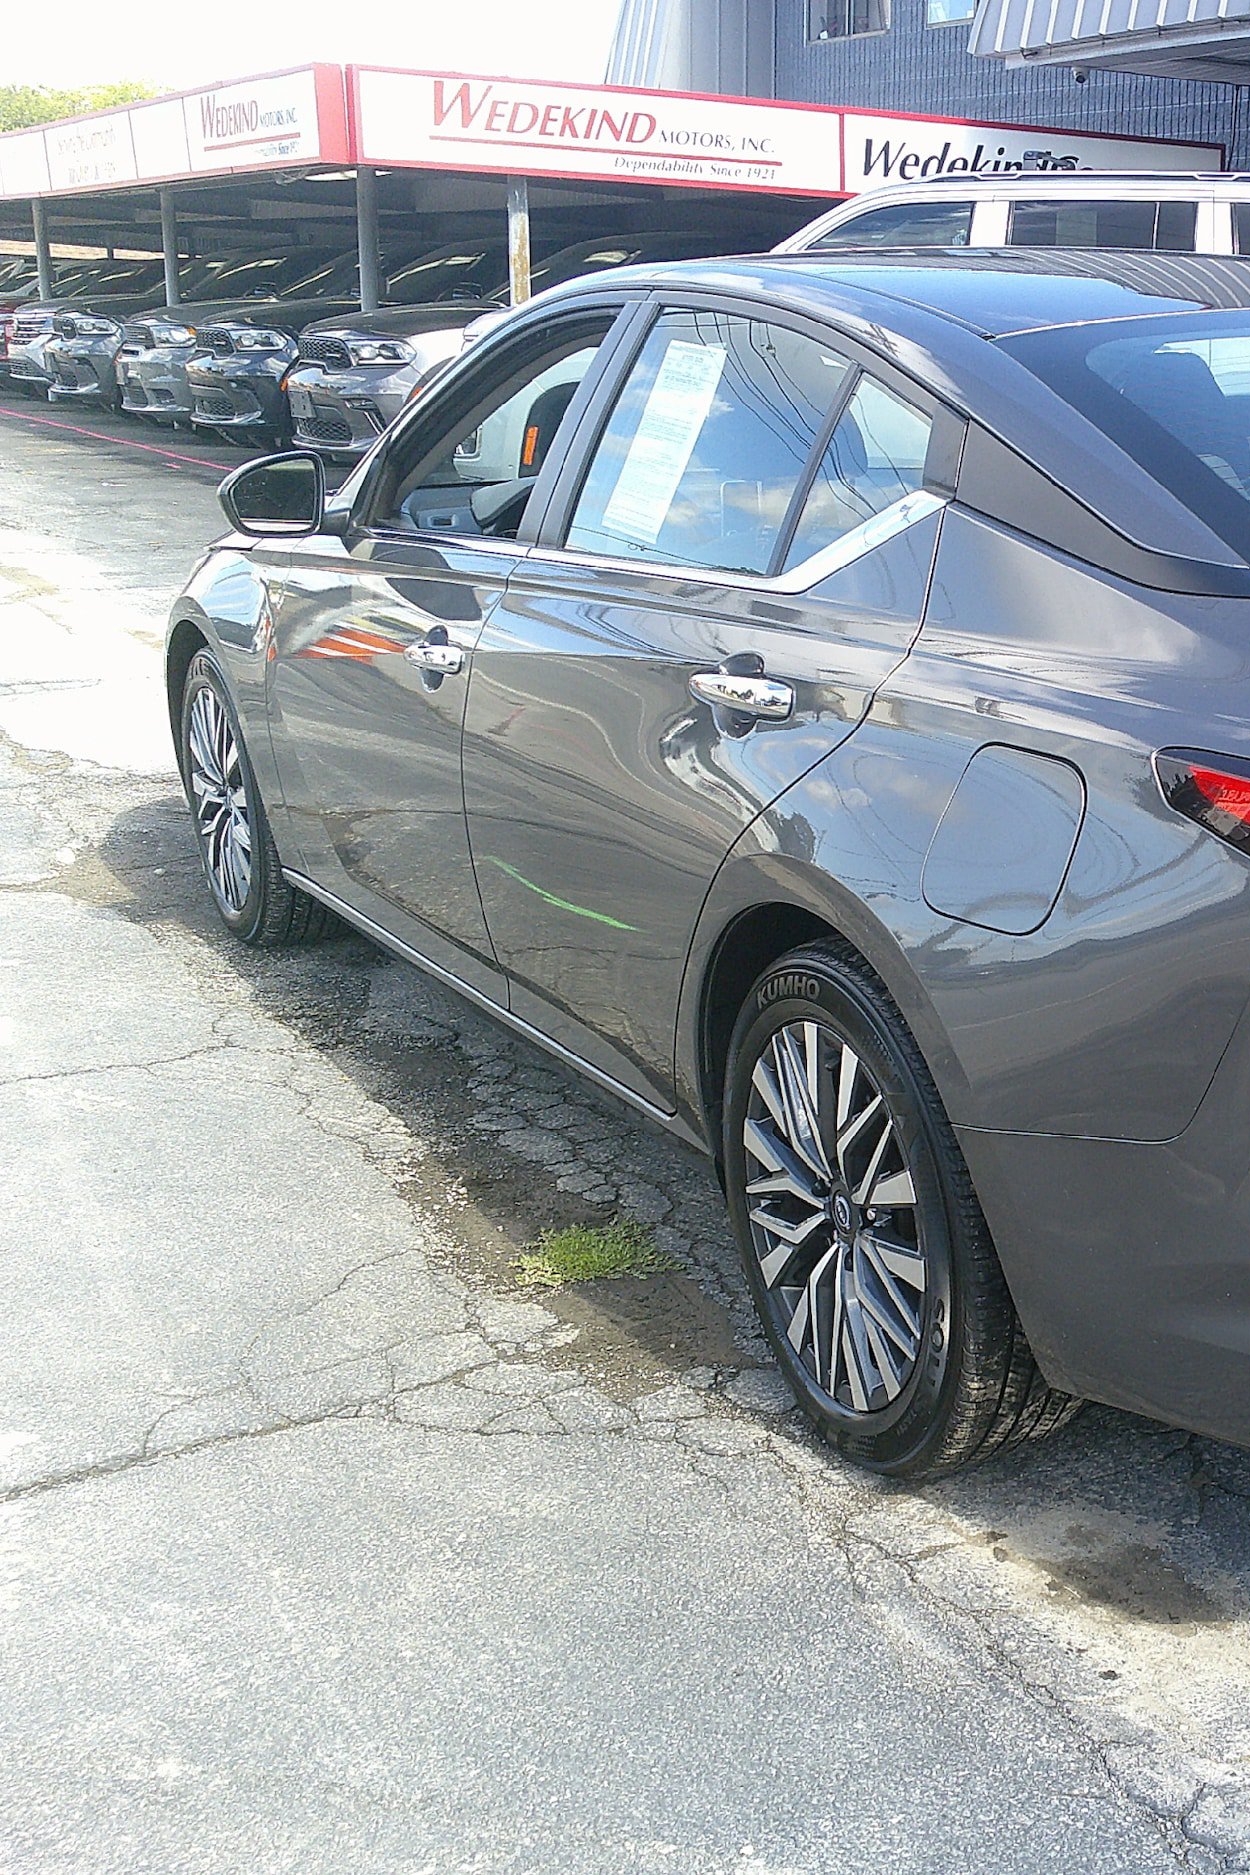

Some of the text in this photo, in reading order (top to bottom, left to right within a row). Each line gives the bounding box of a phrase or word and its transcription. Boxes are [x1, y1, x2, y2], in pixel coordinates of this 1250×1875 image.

[201, 94, 258, 139] WEDEKIND
[433, 80, 775, 153] WEDEKIND MOTORS, INC.
[614, 157, 775, 180] Dependability Since 1921
[757, 975, 821, 1010] KUMHO
